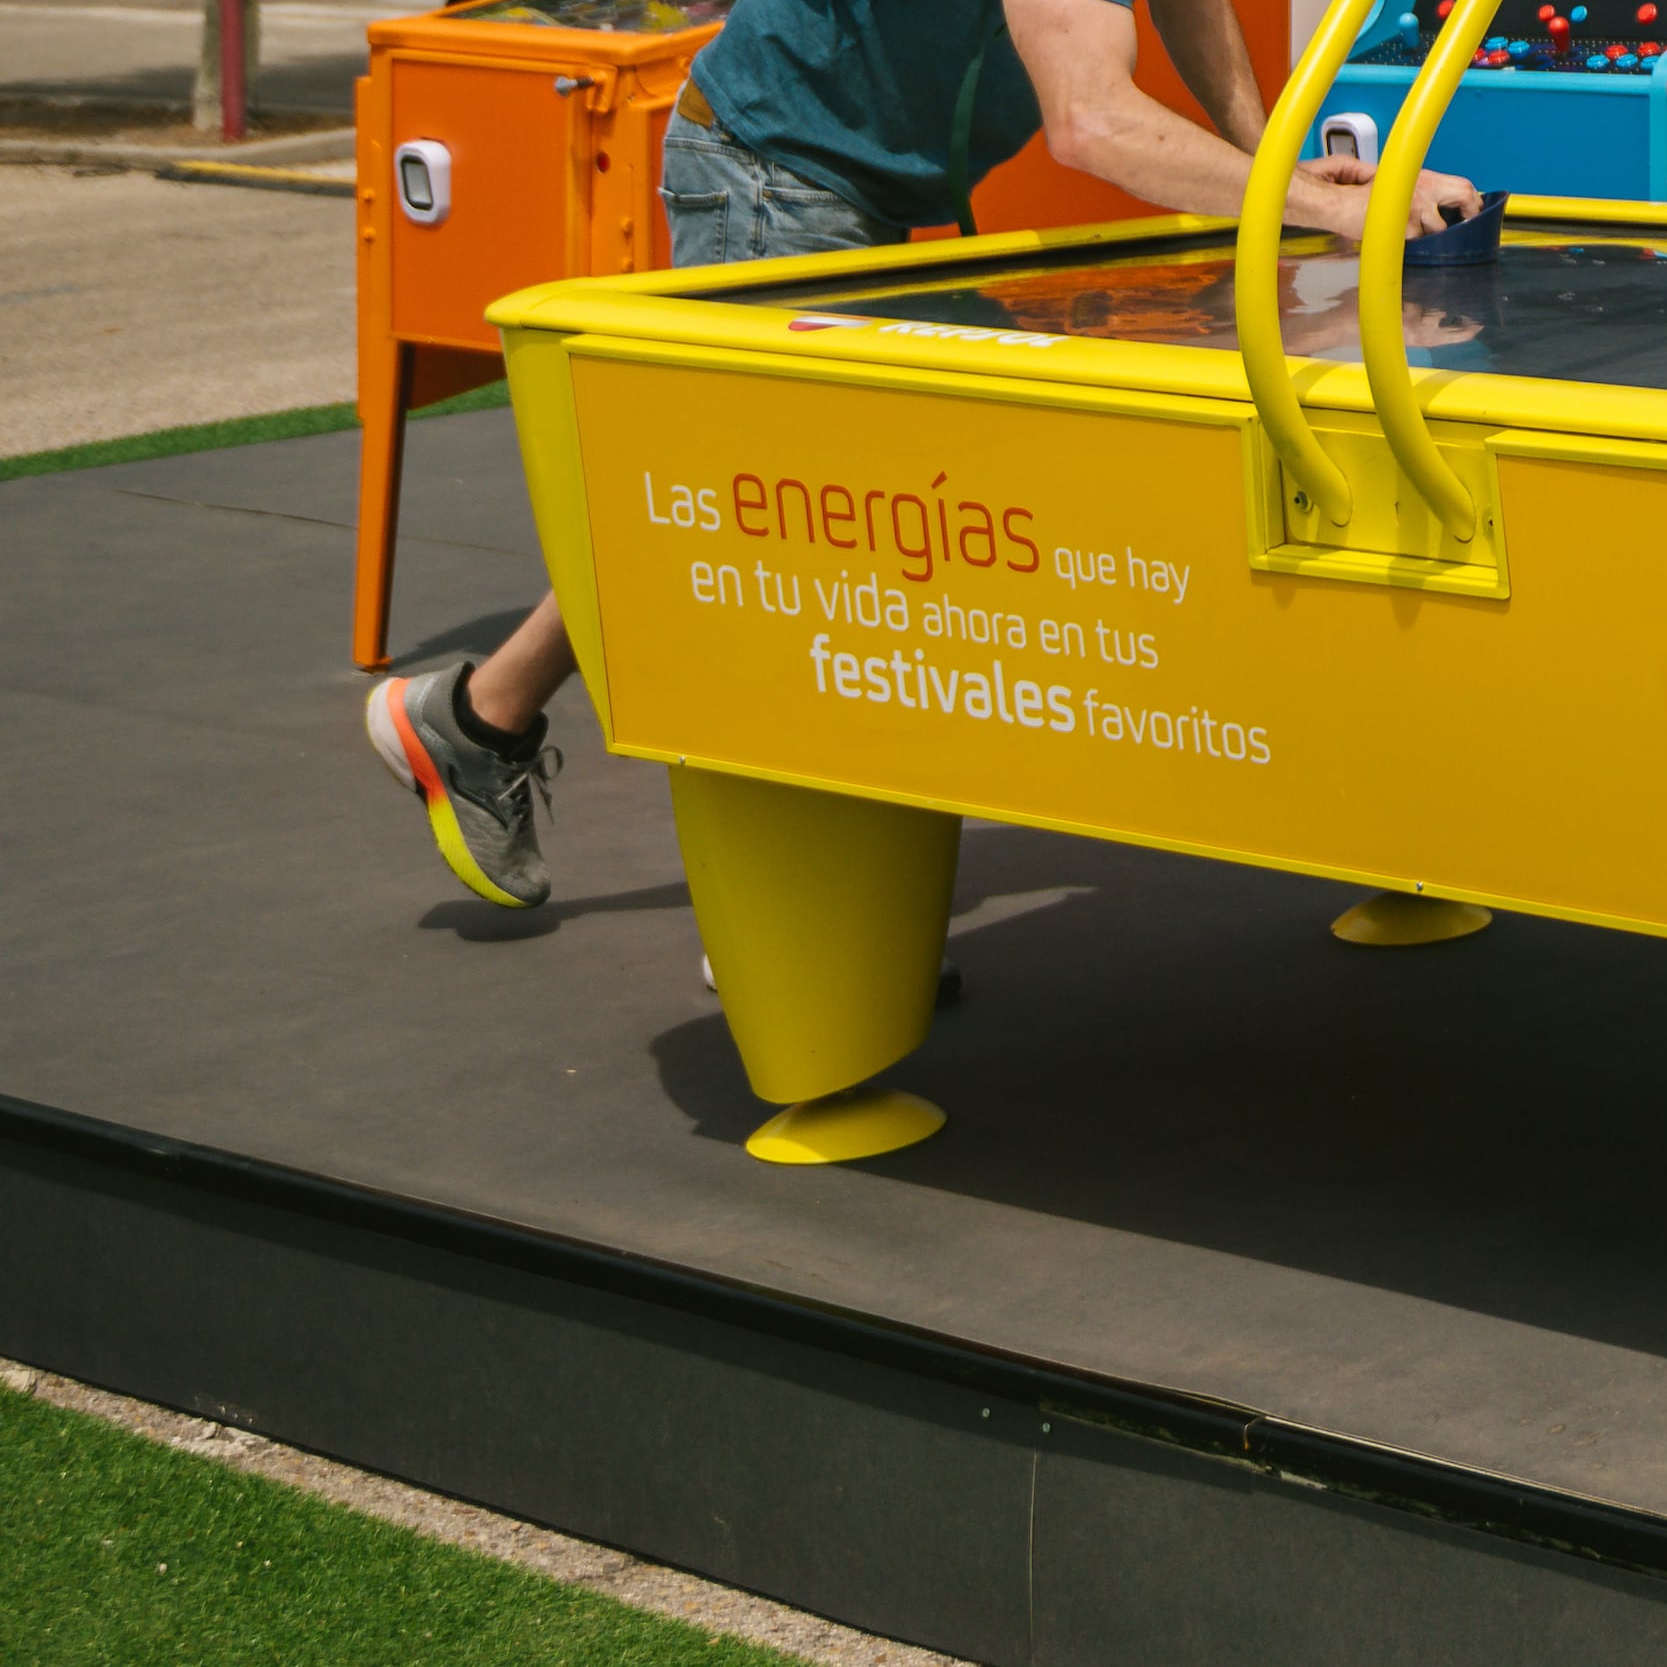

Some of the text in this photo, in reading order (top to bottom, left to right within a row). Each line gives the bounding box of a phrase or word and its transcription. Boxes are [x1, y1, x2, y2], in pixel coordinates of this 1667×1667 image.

[644, 471, 1190, 605] Las energías que hay
[691, 560, 1159, 669] en tu vida ahora en tus
[810, 634, 1271, 764] festivales favoritos
